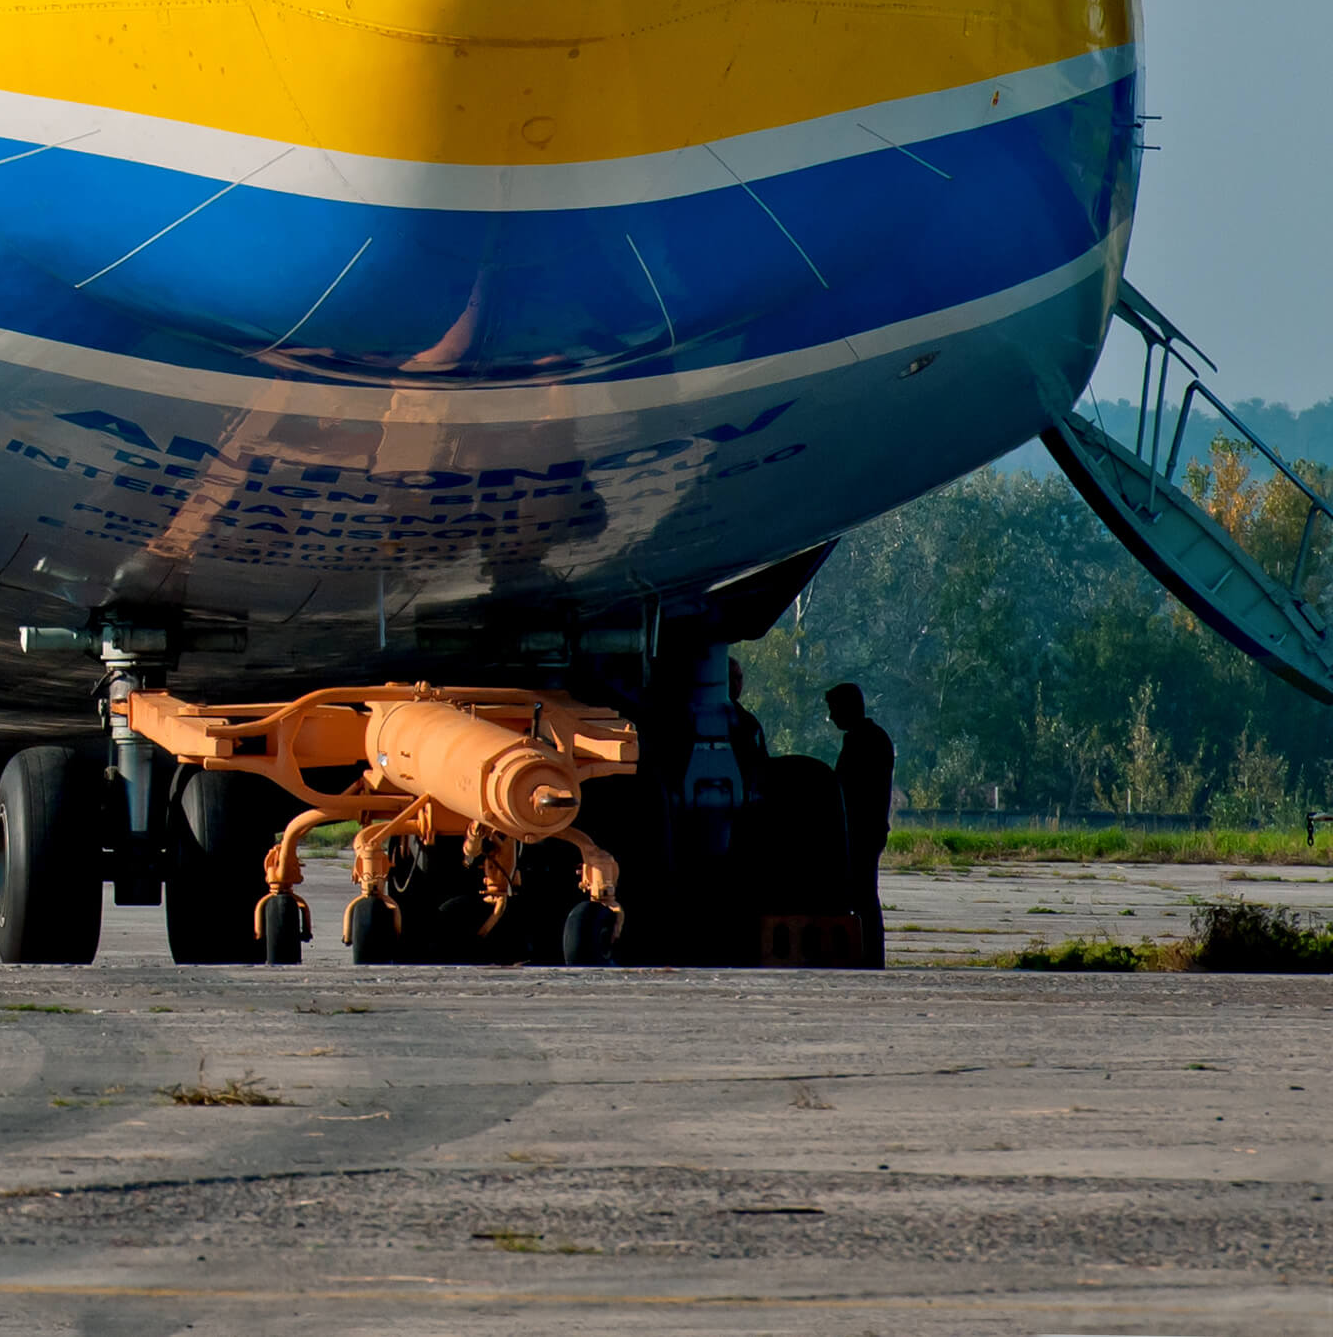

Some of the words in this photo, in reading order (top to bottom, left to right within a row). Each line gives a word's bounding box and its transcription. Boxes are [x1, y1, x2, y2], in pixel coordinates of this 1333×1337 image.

[6, 438, 537, 525] INTERNATIONAL
[52, 398, 801, 490] ANTONOV
[113, 448, 379, 505] DESIGN
[429, 450, 718, 506] BUREAU
